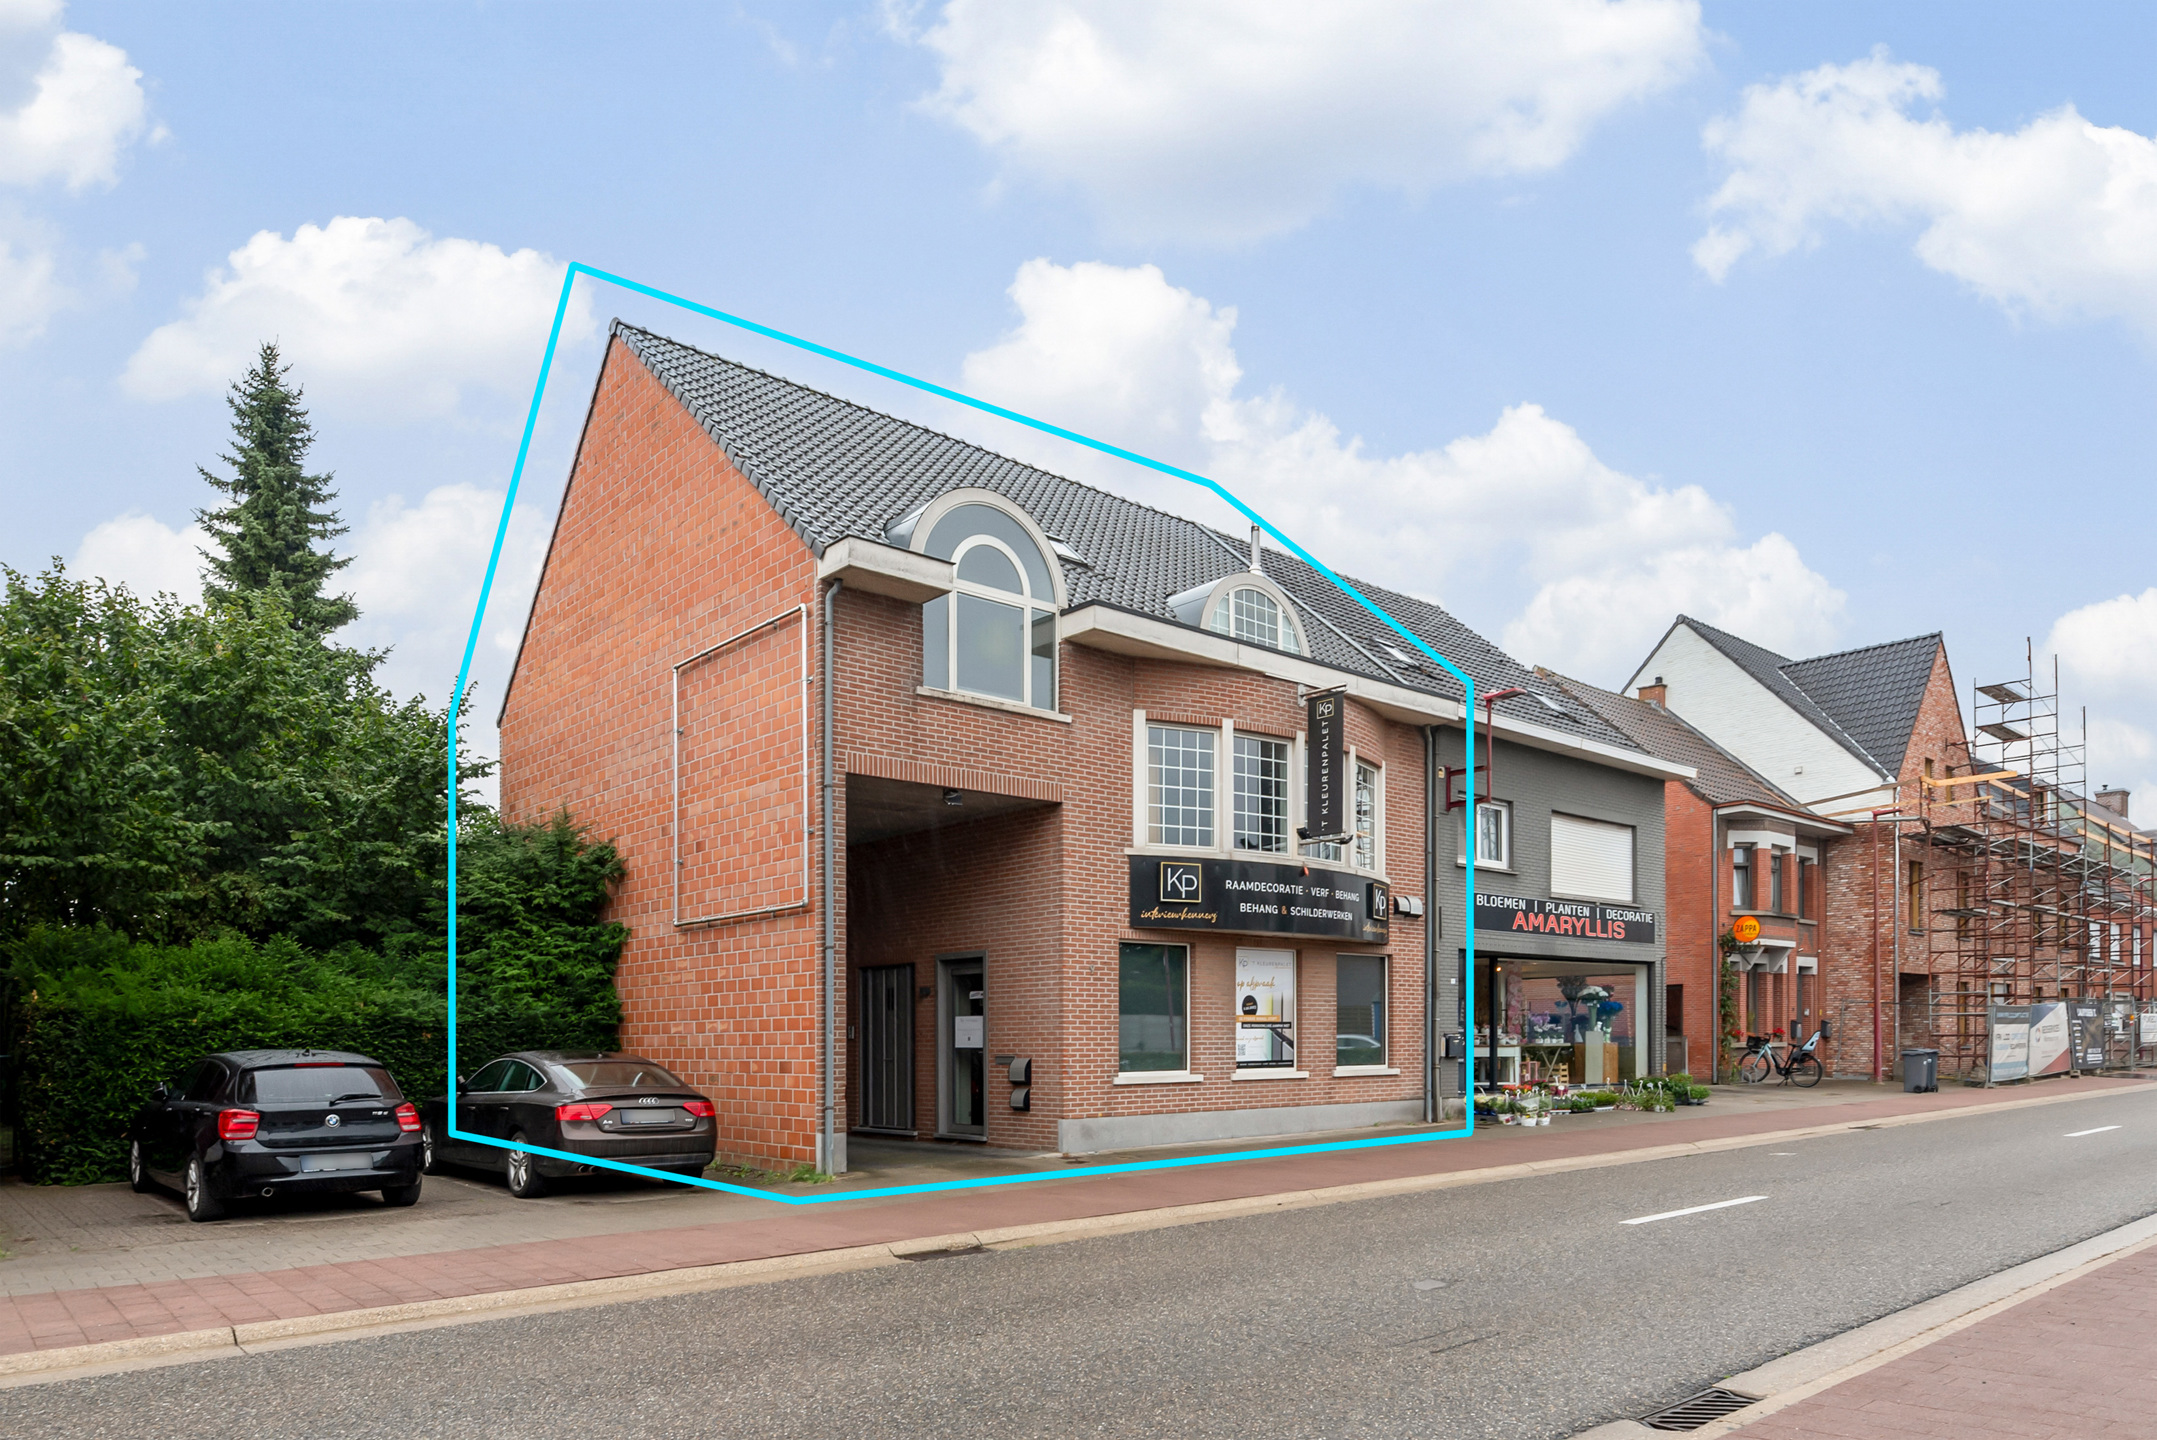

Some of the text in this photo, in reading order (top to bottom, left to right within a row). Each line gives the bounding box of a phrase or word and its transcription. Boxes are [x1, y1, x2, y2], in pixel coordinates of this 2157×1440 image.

[1321, 721, 1329, 815] KLEURENPALET
[1225, 879, 1360, 902] RAAMDECORATIE VERF BEHANG
[1239, 902, 1353, 921] BEHANG & SCHILDERWERKEN
[1476, 894, 1653, 924] BLOEMEN PLANTEN DECORATIE
[1512, 911, 1626, 939] AMARYLLIS
